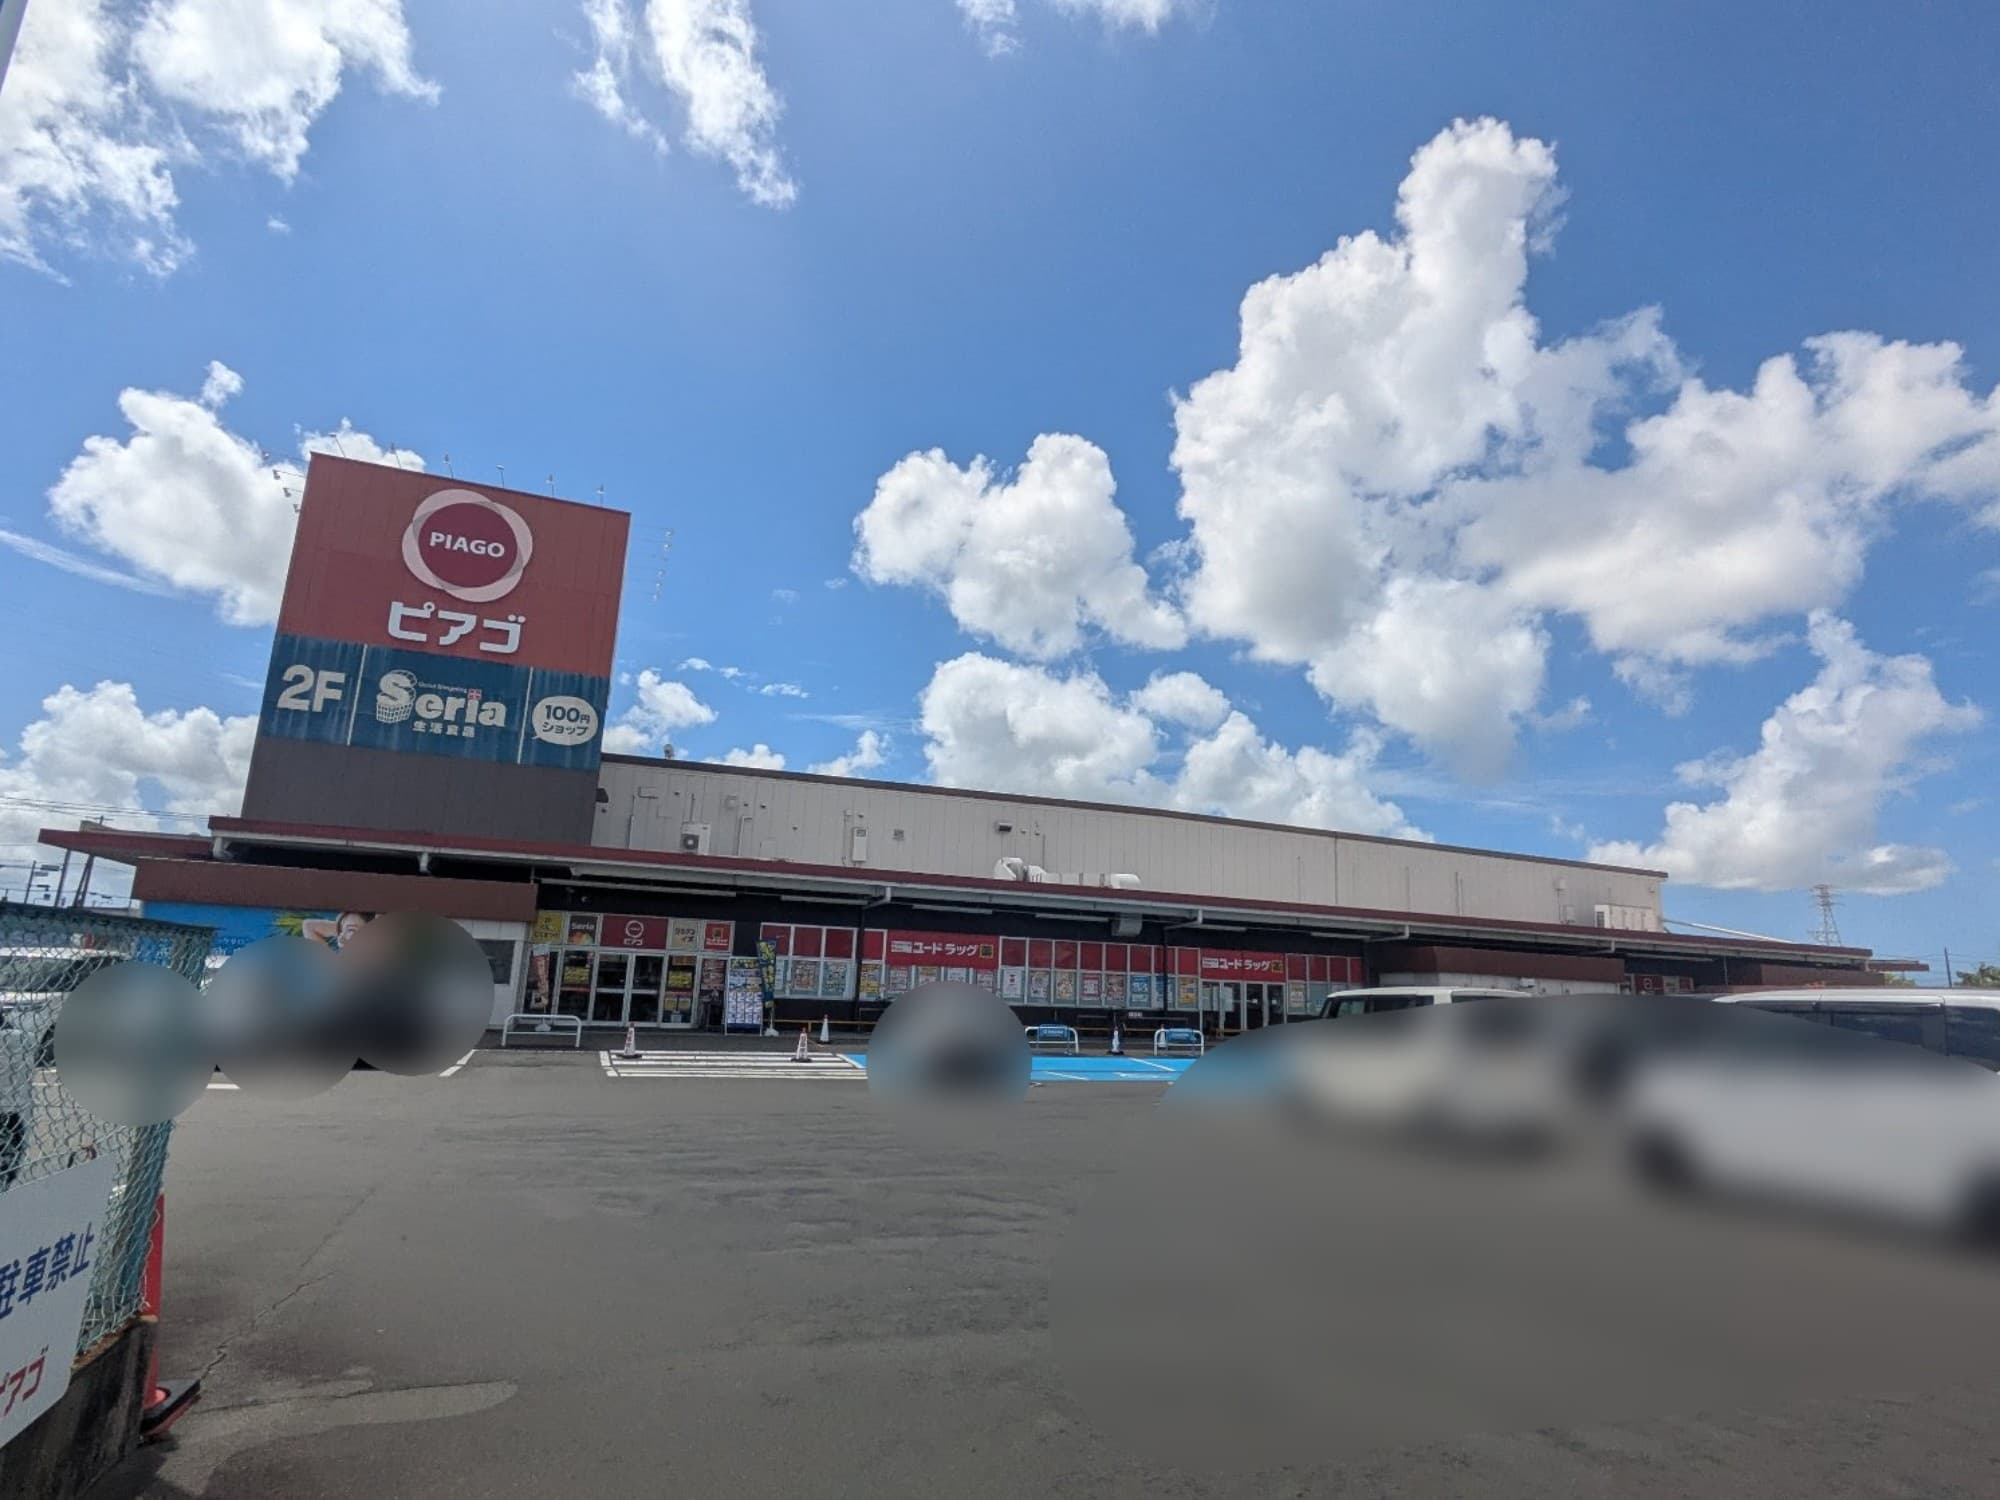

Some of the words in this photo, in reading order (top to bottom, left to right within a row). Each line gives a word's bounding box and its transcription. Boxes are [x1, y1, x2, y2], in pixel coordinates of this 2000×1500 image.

[429, 531, 505, 558] PIAGO
[387, 601, 526, 654] ピアゴ
[276, 664, 345, 713] 2F
[376, 669, 506, 728] Seria
[541, 722, 589, 737] ショップ
[544, 704, 591, 725] 100円
